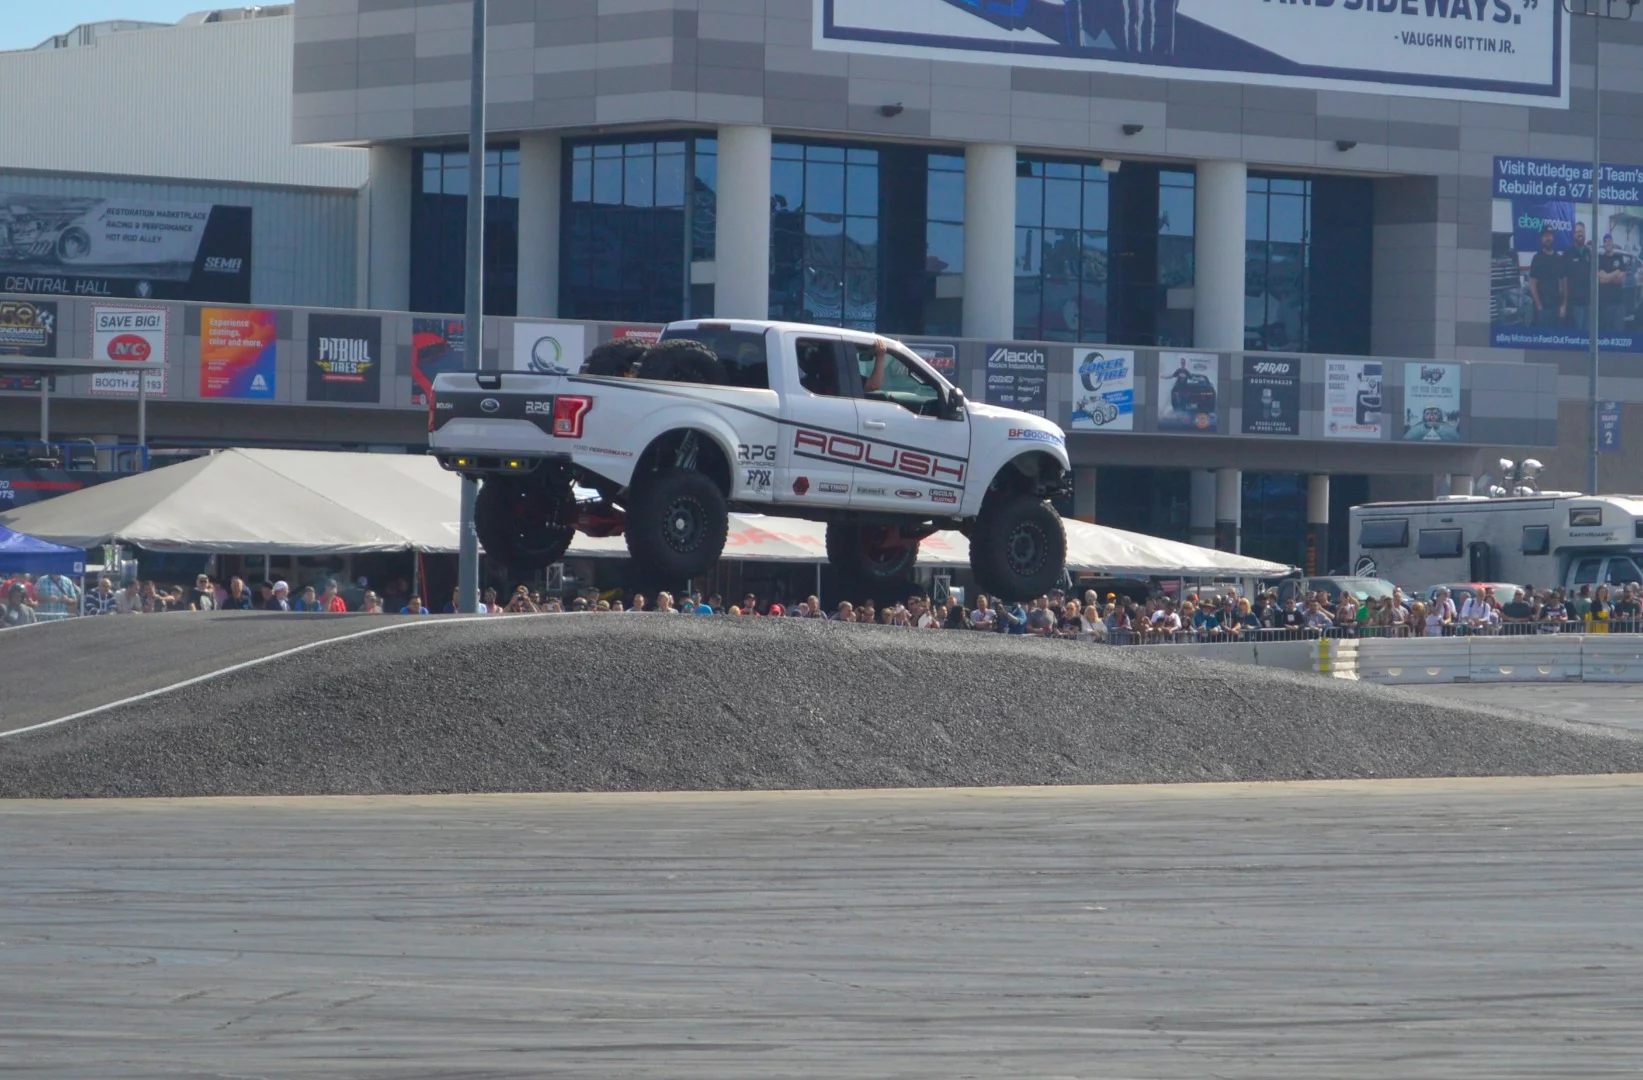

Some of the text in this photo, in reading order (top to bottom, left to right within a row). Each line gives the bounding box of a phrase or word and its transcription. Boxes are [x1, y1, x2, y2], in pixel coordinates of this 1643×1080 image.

[1401, 31, 1452, 48] VAUGHN
[1455, 36, 1496, 52] GITTIN
[1498, 40, 1515, 54] JR.
[1499, 160, 1525, 176] Visit
[1528, 163, 1580, 182] Rutledge
[1605, 167, 1643, 184] Team's
[1499, 179, 1639, 201] Rebuild of a '67 Fstback
[106, 207, 207, 221] RESTORATION MARKETPLACE
[106, 221, 133, 229] RACING
[142, 223, 193, 232] PERFORMANCE
[105, 233, 120, 241] HOT
[139, 235, 162, 243] ALLEY
[5, 276, 111, 295] CENTRAL HALL
[100, 315, 160, 327] SAVE BIG!
[209, 318, 249, 327] Experience
[208, 338, 226, 346] color
[228, 339, 241, 347] and
[112, 343, 146, 356] NC
[319, 337, 371, 362] PITBULL
[330, 361, 358, 374] TIRES
[1253, 362, 1290, 374] FARAD
[1096, 367, 1129, 384] TIRE
[95, 378, 162, 390] BOOTH #2193
[525, 401, 550, 411] RPG
[1008, 428, 1059, 443] BFGood
[1605, 431, 1613, 444] 2
[589, 446, 634, 457] PERFORMANCE
[737, 444, 776, 460] RPG
[794, 429, 964, 482] ROUSH
[746, 469, 772, 486] FOX
